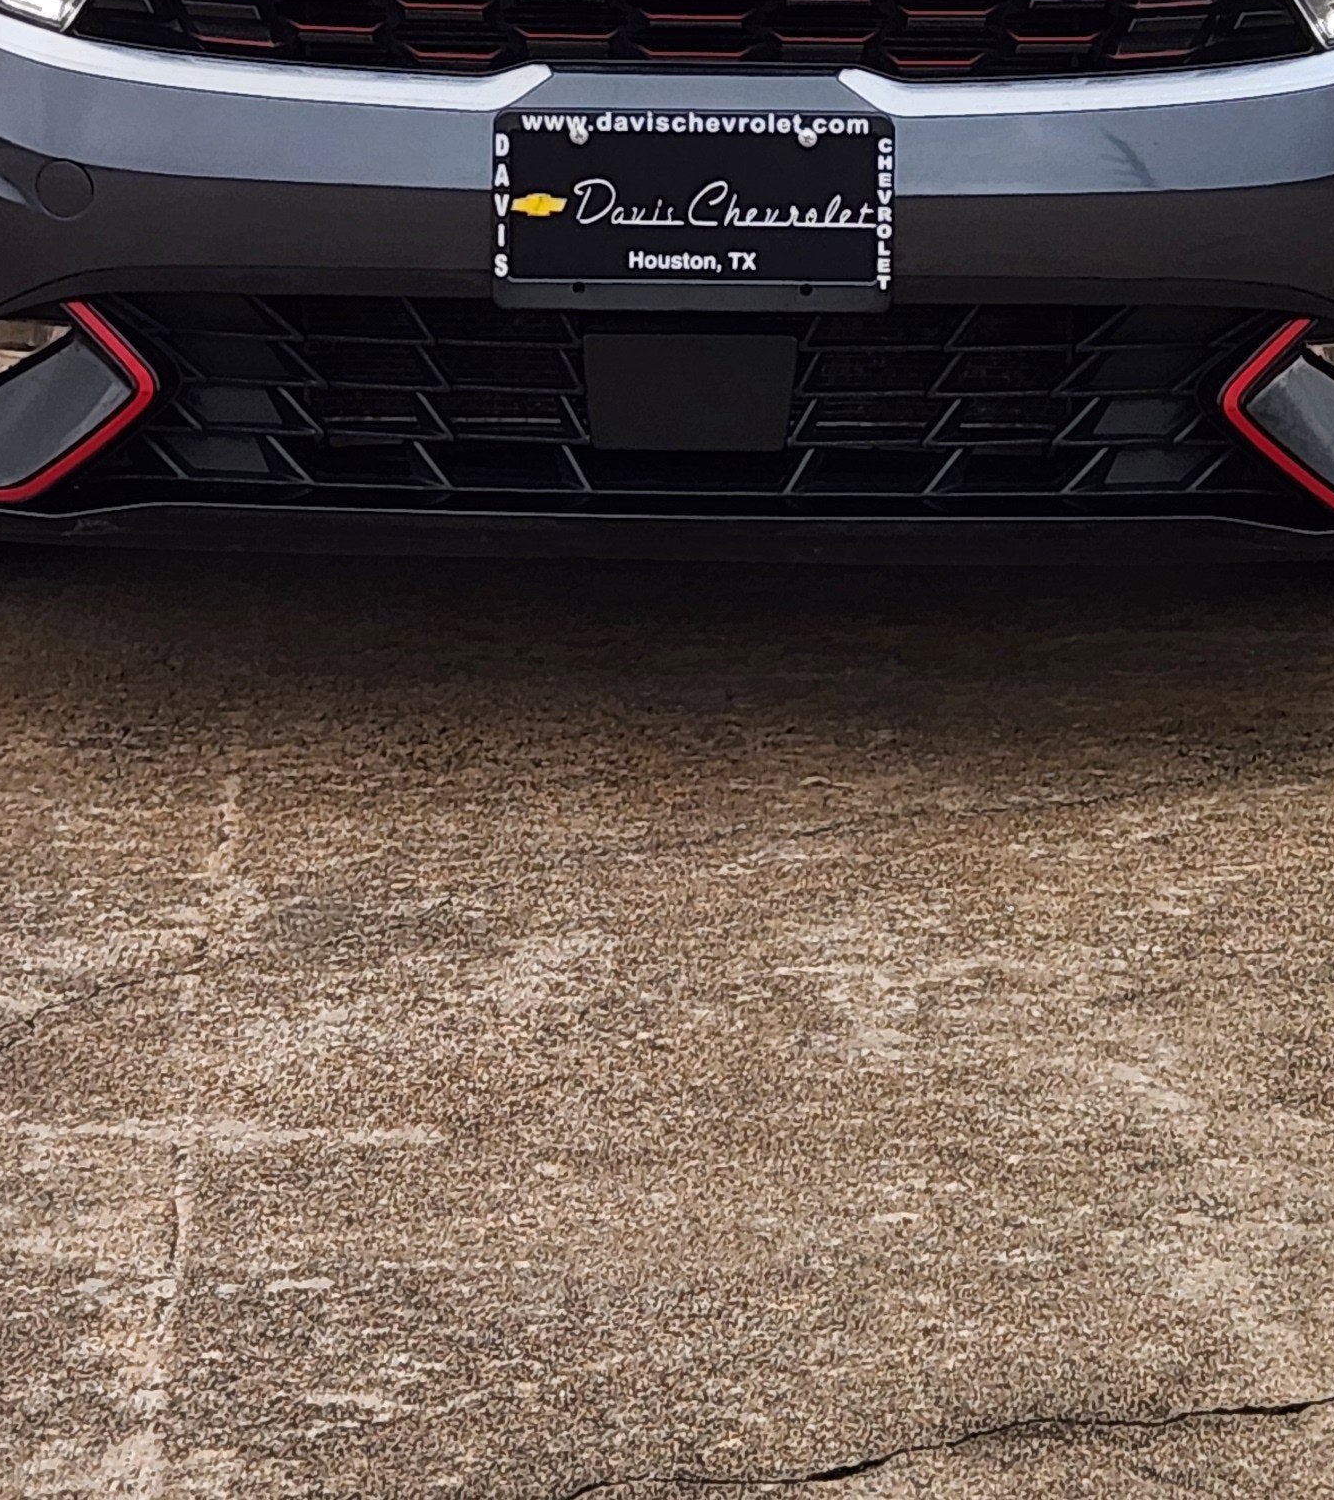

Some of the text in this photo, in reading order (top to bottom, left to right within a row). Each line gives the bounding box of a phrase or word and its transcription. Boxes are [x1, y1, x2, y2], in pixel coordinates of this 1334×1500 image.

[494, 133, 510, 278] DAVIS
[573, 179, 877, 229] Davis Chevrolet
[876, 138, 893, 290] CHEVROLET
[628, 251, 757, 273] Houston, TX
